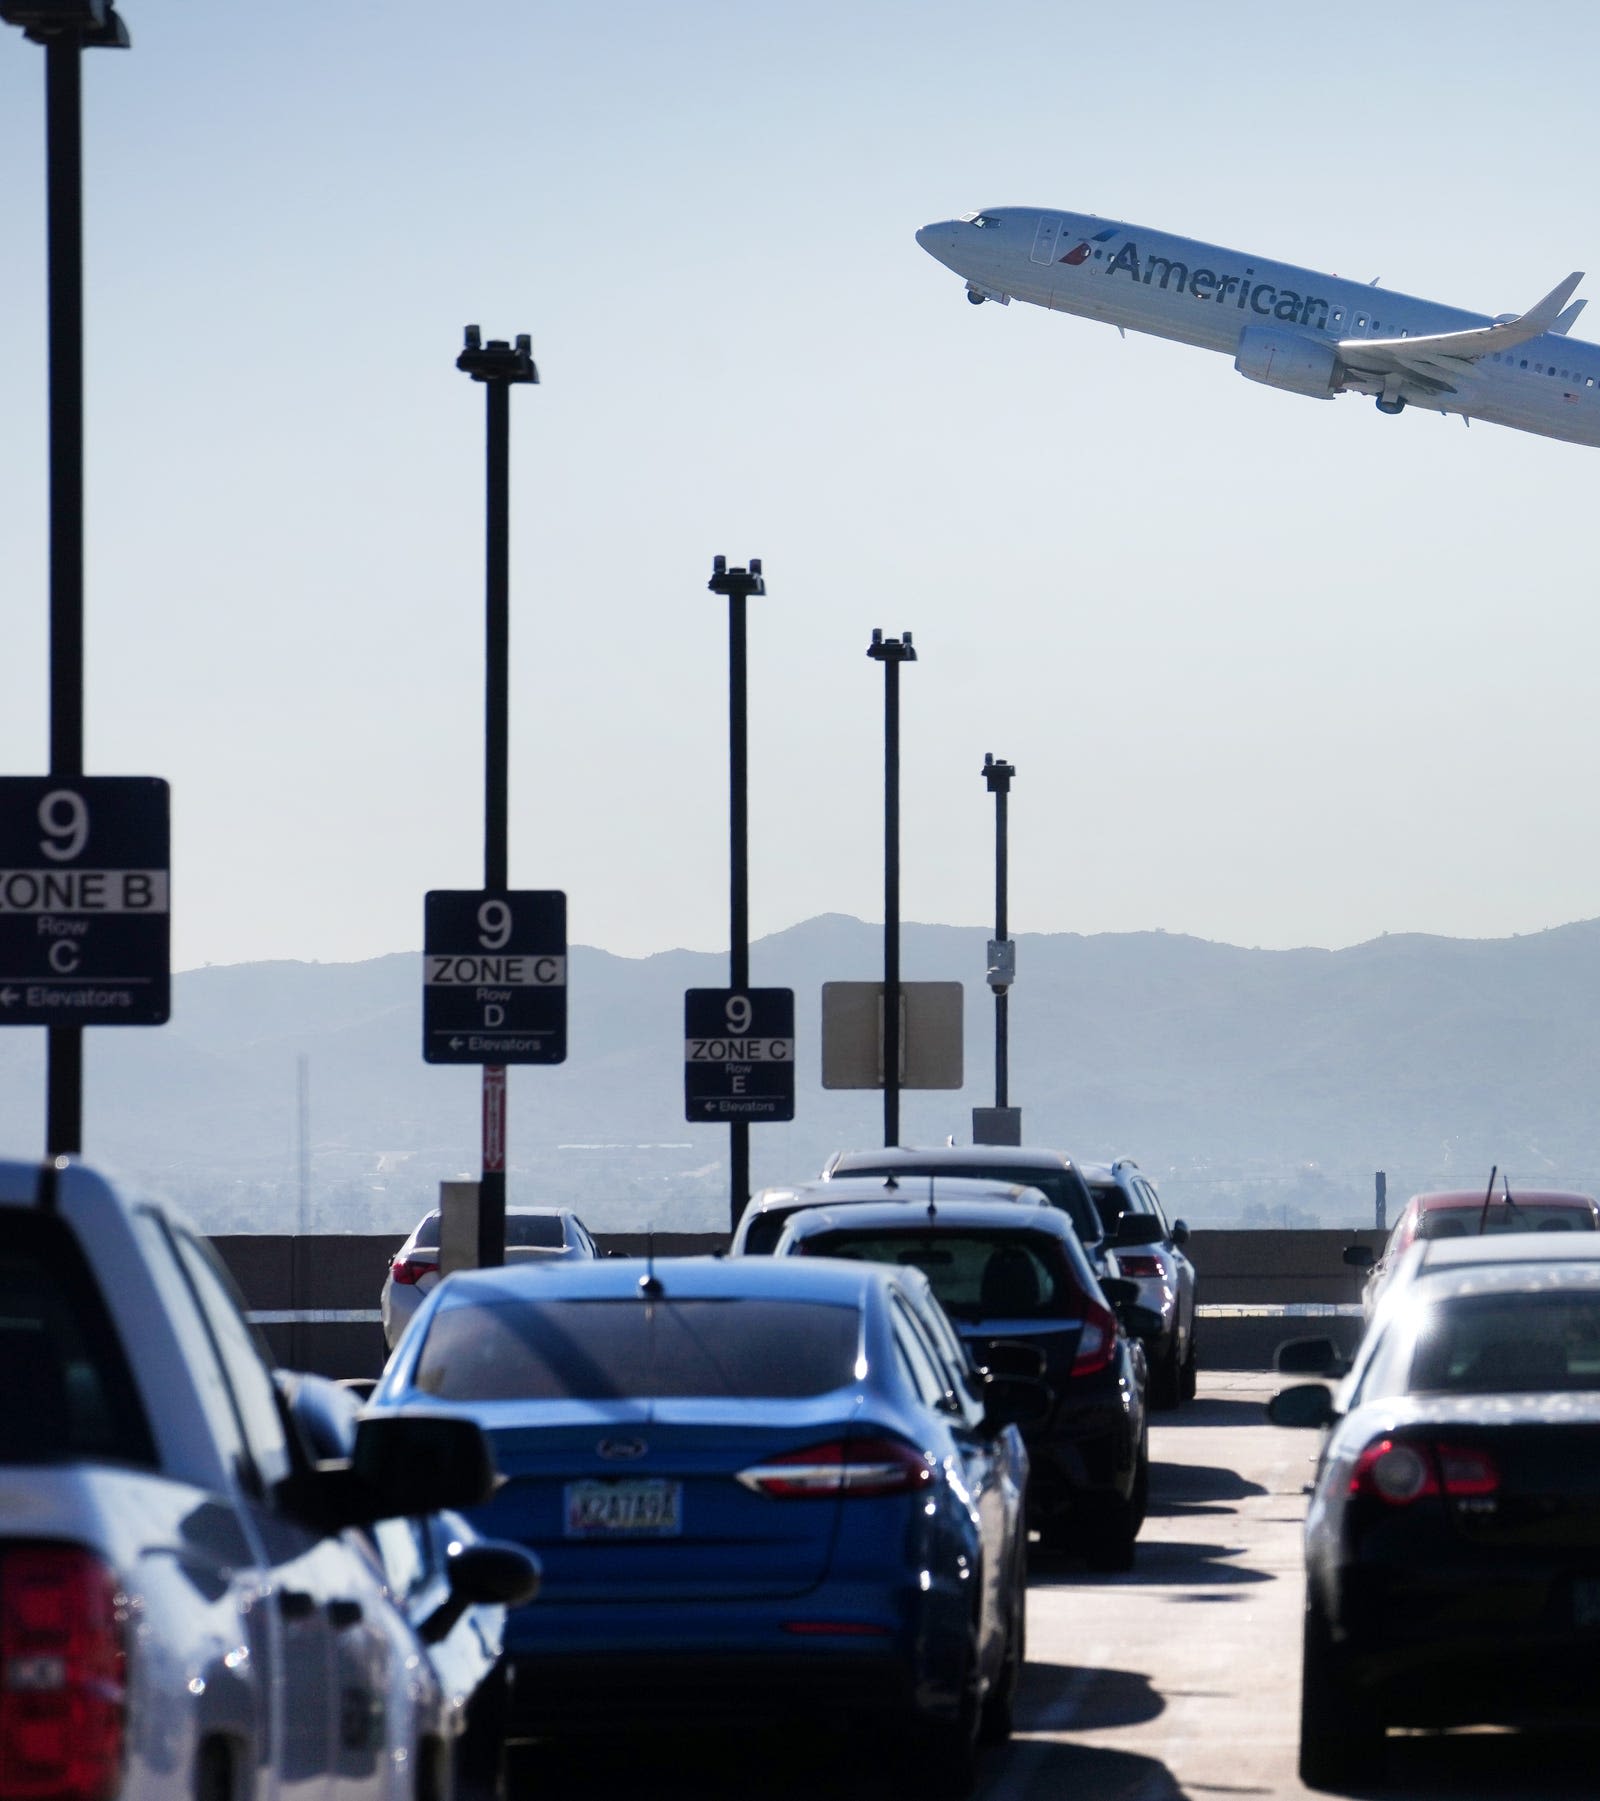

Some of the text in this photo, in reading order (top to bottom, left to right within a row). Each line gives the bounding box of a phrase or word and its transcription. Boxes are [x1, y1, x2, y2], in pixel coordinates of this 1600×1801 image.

[1105, 242, 1330, 330] American
[38, 789, 89, 862] 9
[123, 875, 152, 908] B
[38, 918, 89, 935] Row
[478, 900, 512, 949] 9
[49, 940, 79, 973] C
[433, 958, 556, 983] ZONE C
[27, 988, 132, 1007] Elevators
[477, 989, 512, 1001] Row
[485, 1005, 504, 1026] D
[726, 995, 752, 1034] 9
[469, 1037, 541, 1050] Elevators
[692, 1041, 786, 1059] ZONE C
[726, 1064, 752, 1074] Row
[733, 1076, 745, 1093] E
[720, 1101, 775, 1111] Elevators
